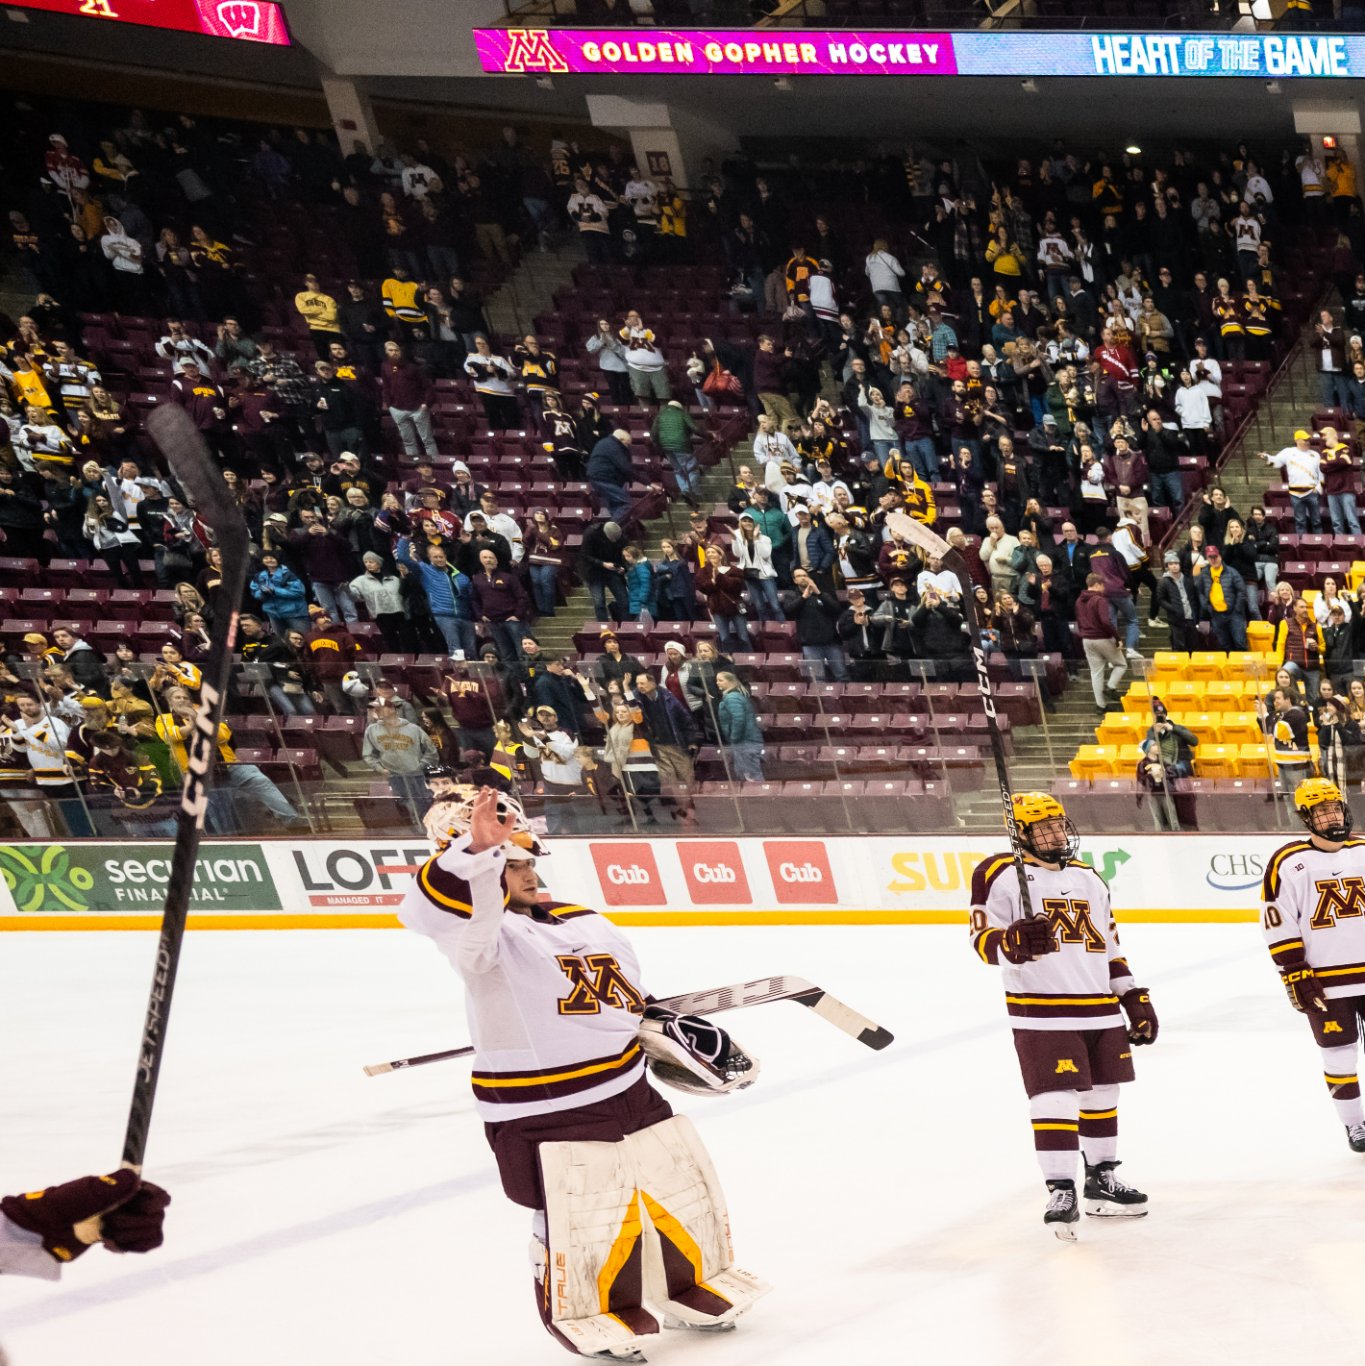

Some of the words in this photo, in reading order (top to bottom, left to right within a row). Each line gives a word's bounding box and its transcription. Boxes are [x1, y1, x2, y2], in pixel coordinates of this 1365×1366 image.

[582, 41, 694, 64] GOLDEN
[705, 42, 817, 64] GOPHER
[828, 43, 939, 65] HOCKEY
[1091, 36, 1181, 74] HEART
[1184, 40, 1214, 70] OF
[1218, 40, 1260, 71] THE
[1264, 37, 1348, 76] GAME
[972, 646, 998, 720] CCM
[1003, 795, 1025, 865] JETSPEED
[606, 864, 650, 885] Cub
[693, 863, 736, 884] Cub
[779, 862, 823, 883] Cub
[1210, 854, 1264, 877] CHS
[327, 896, 371, 905] MANAGED
[375, 896, 385, 904] IT
[557, 954, 646, 1016] M
[554, 1251, 567, 1316] TRUE
